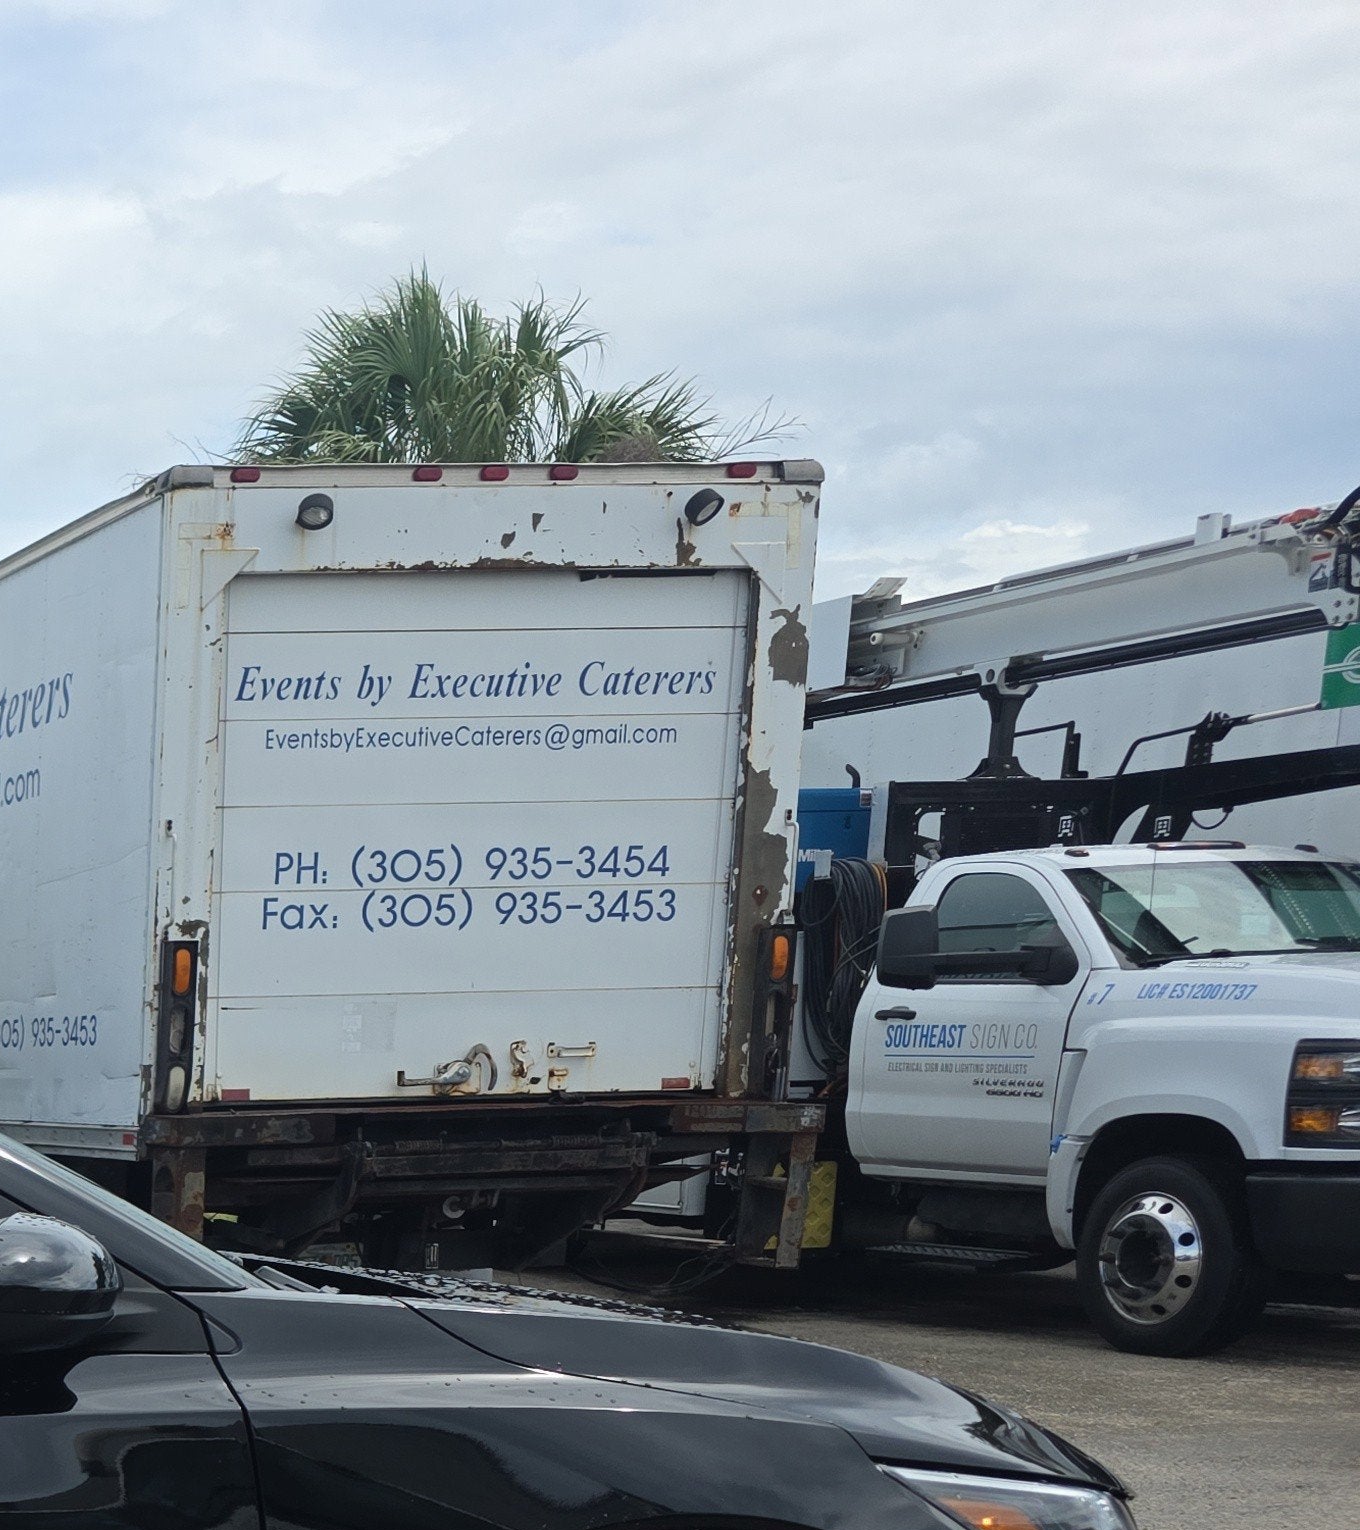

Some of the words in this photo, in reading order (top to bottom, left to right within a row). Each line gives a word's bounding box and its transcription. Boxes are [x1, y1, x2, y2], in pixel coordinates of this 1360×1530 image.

[233, 664, 343, 703] Events
[356, 663, 393, 707] by
[408, 660, 564, 701] Executive
[578, 659, 718, 699] Caterers
[264, 722, 678, 753] EventsbyExecutiveCaterers@gmail.com
[273, 851, 329, 885] PH:
[350, 843, 464, 888] (305)
[484, 844, 671, 882] 935-3454
[261, 896, 340, 932] Fax:
[361, 889, 474, 934] (305)
[494, 888, 678, 926] 935-3453
[1137, 983, 1170, 1000] LIC#
[1168, 983, 1258, 1001] ES12001737
[31, 1014, 98, 1047] 935-3453
[884, 1023, 967, 1049] SOUTHEAST
[969, 1022, 1010, 1050] SIGN
[1013, 1022, 1039, 1050] CO.
[887, 1061, 923, 1073] ELECTRICAL
[923, 1062, 939, 1073] SIGN
[940, 1063, 953, 1073] AND
[954, 1063, 985, 1074] LIGHTING
[985, 1063, 1028, 1075] SPECIALISTS
